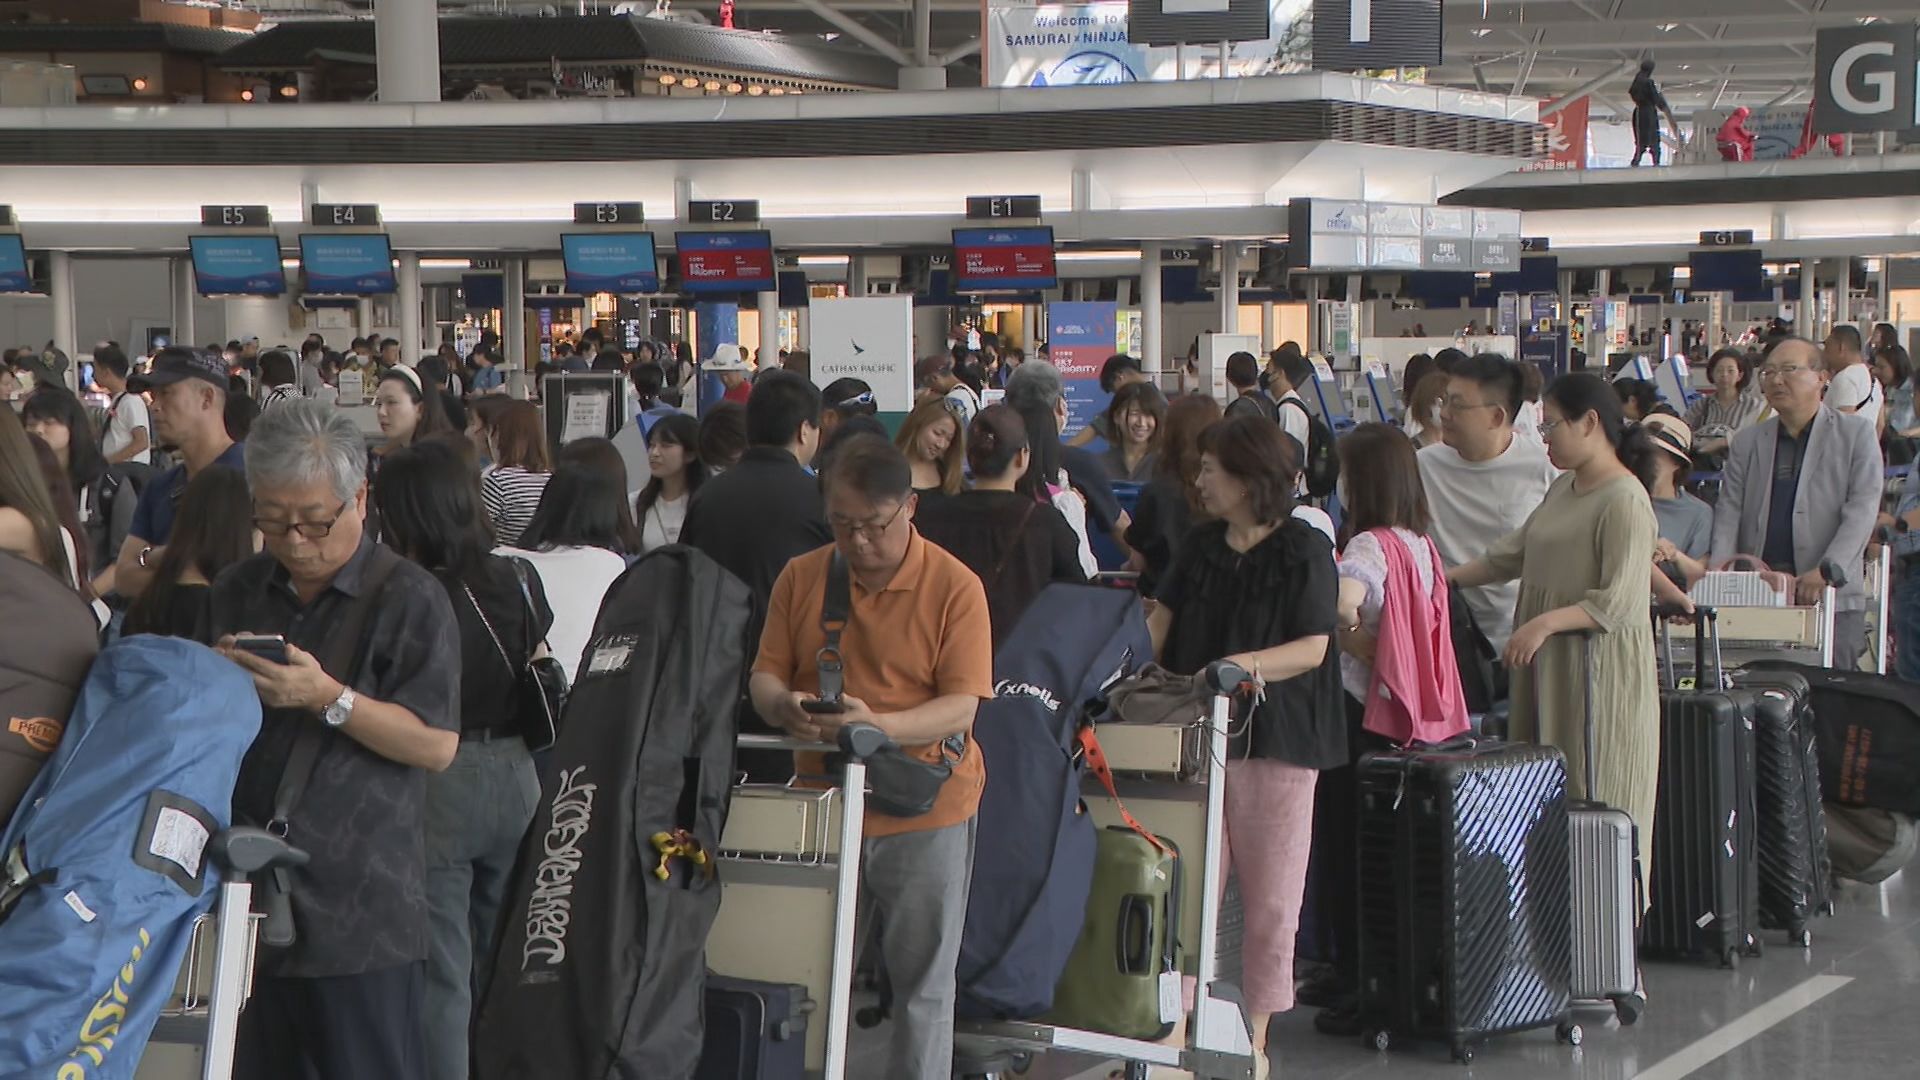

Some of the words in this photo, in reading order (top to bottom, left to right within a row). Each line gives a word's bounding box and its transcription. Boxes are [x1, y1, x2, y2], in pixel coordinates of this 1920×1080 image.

[1036, 15, 1099, 27] Welcome
[1104, 14, 1119, 25] to
[1005, 33, 1071, 46] SAMURAI
[1083, 31, 1127, 43] NINJA
[1830, 41, 1896, 115] G
[333, 206, 355, 224] E4
[596, 205, 618, 222] E3
[711, 203, 734, 221] E2
[991, 199, 1012, 216] E1
[223, 207, 244, 225] E5
[1715, 233, 1735, 244] G1
[821, 365, 858, 373] CATHAY
[860, 364, 896, 373] PACIFIC
[1054, 358, 1073, 366] SKY
[1060, 365, 1097, 374] RIORITY
